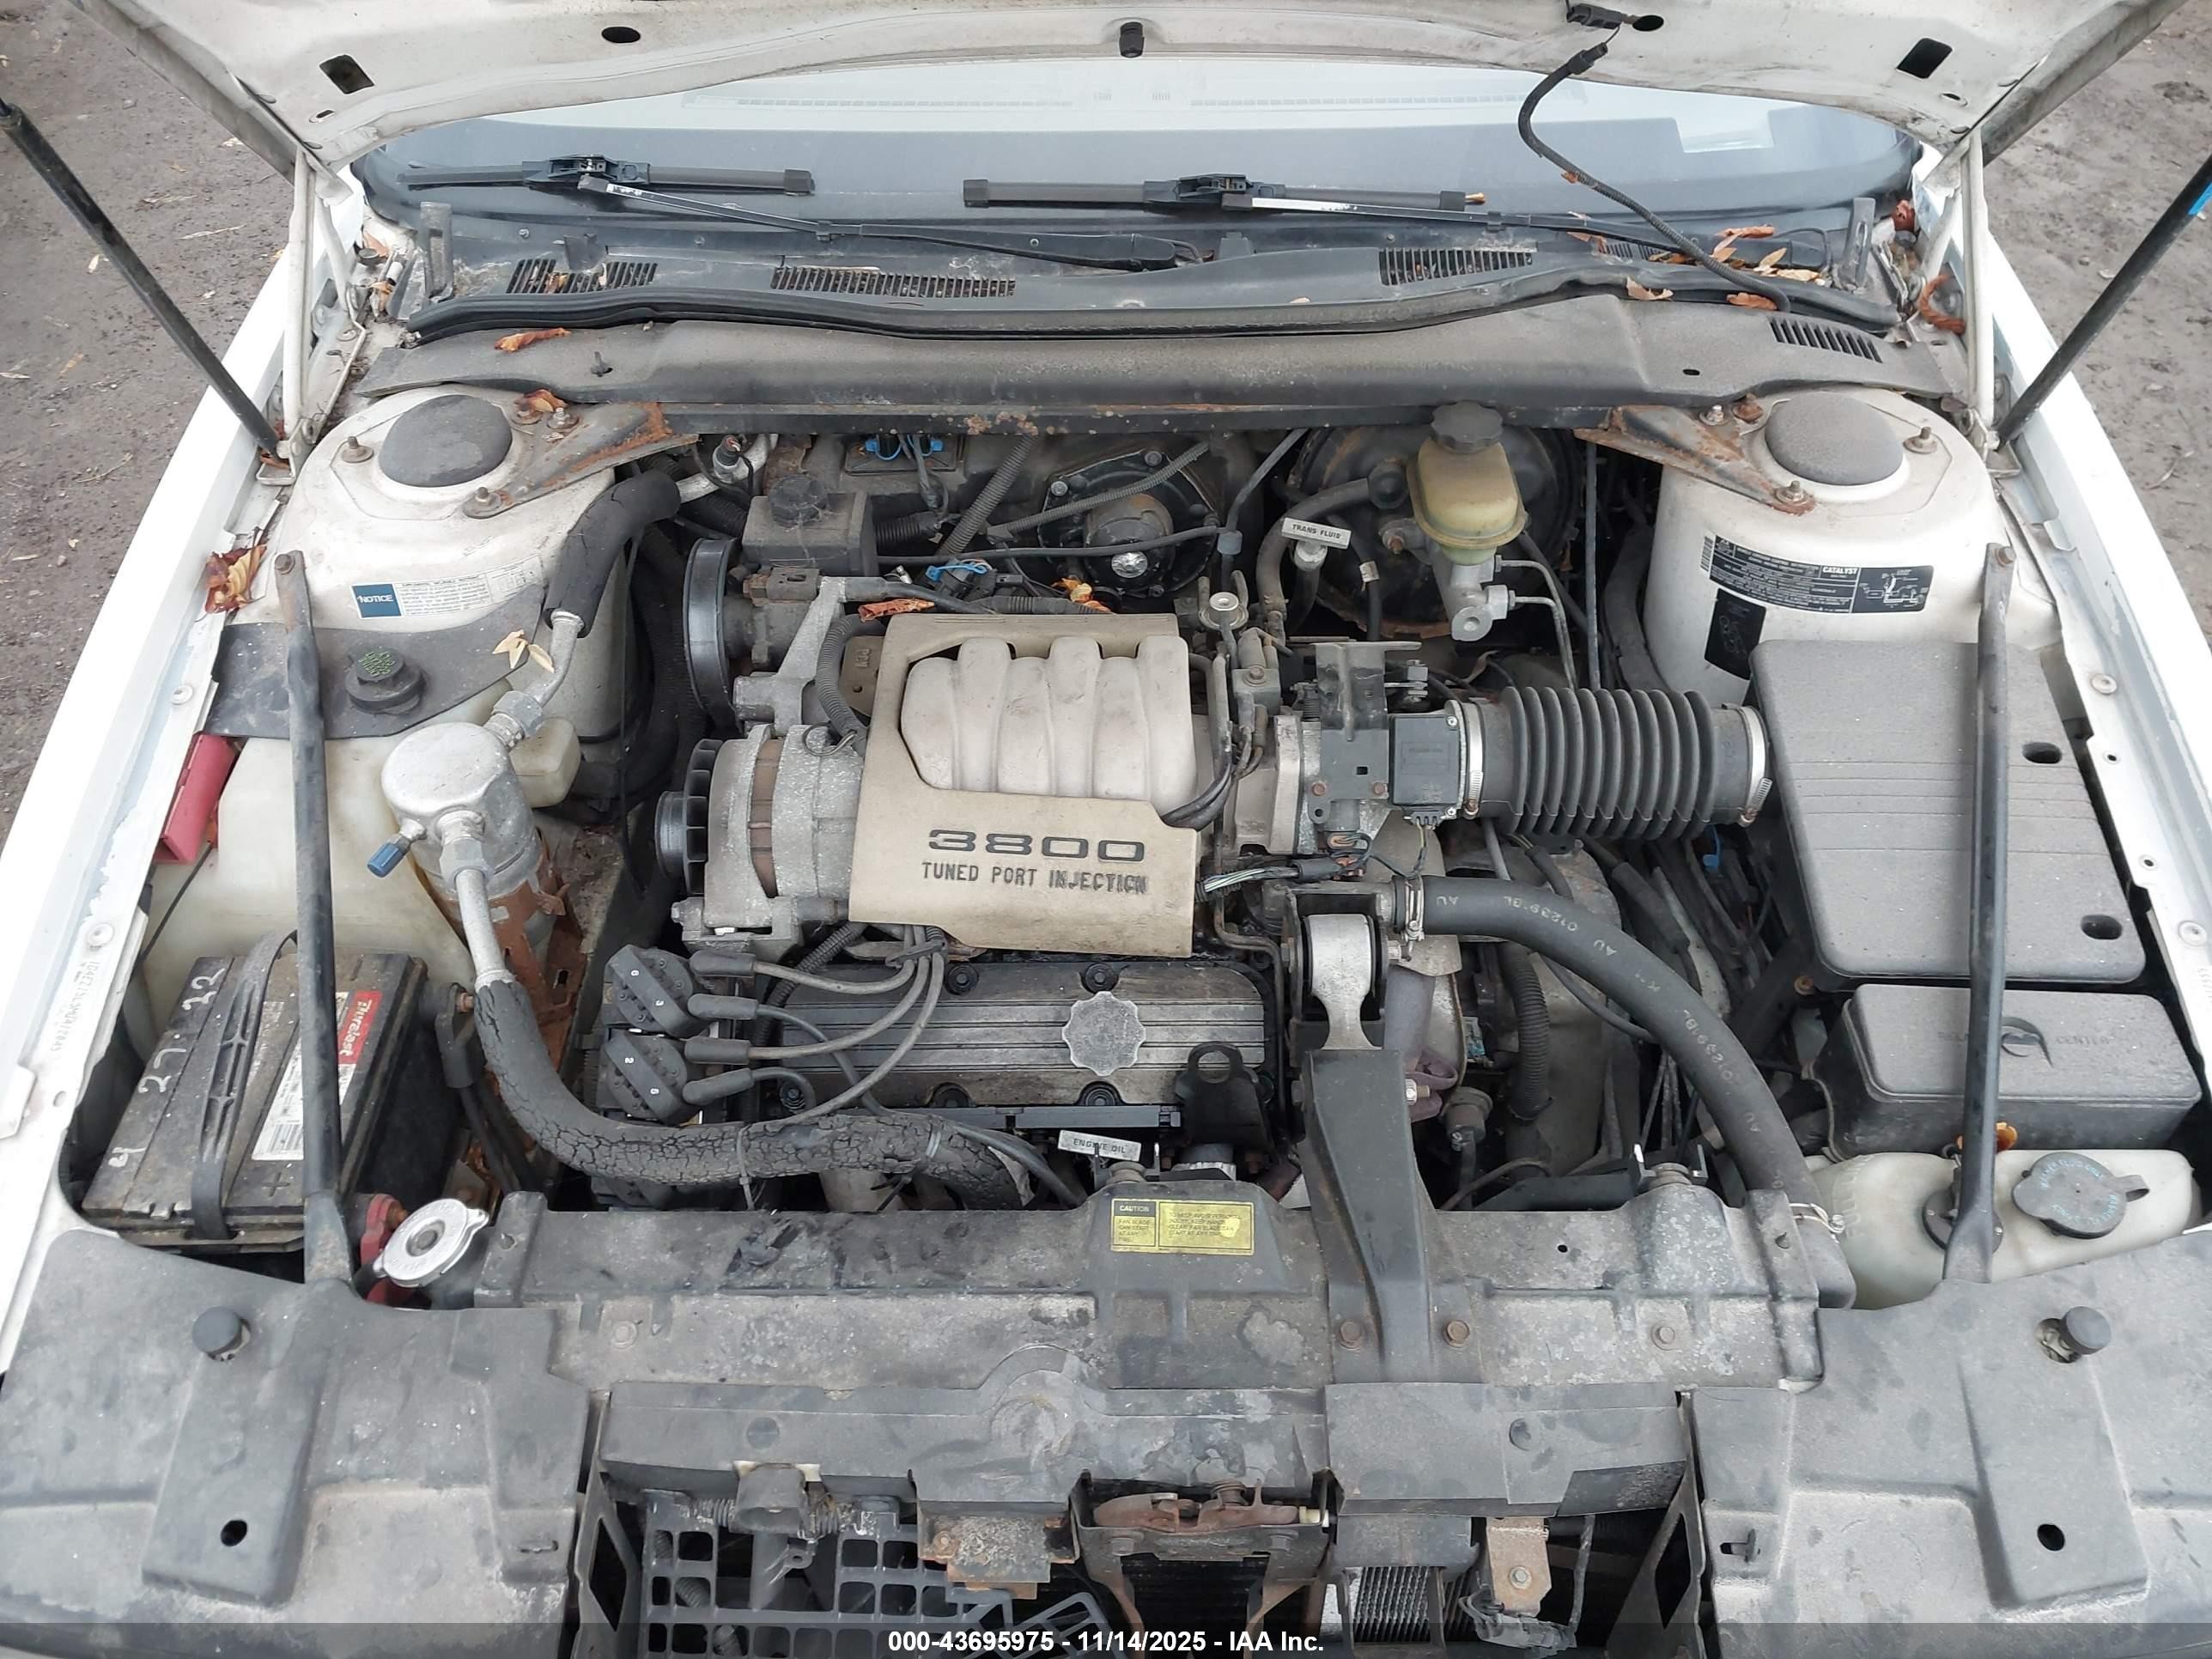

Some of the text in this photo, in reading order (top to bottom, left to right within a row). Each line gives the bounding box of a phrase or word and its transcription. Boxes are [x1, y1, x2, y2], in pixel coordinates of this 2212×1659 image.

[1291, 524, 1341, 539] TRANS FLUID
[1821, 566, 1858, 575] CATALYST
[362, 594, 393, 603] NOTICE
[928, 829, 1145, 862] 3800
[922, 862, 1149, 895] TUNED PORT INJECTION
[339, 999, 374, 1057] Duralast
[1111, 1145, 1126, 1153] OIL
